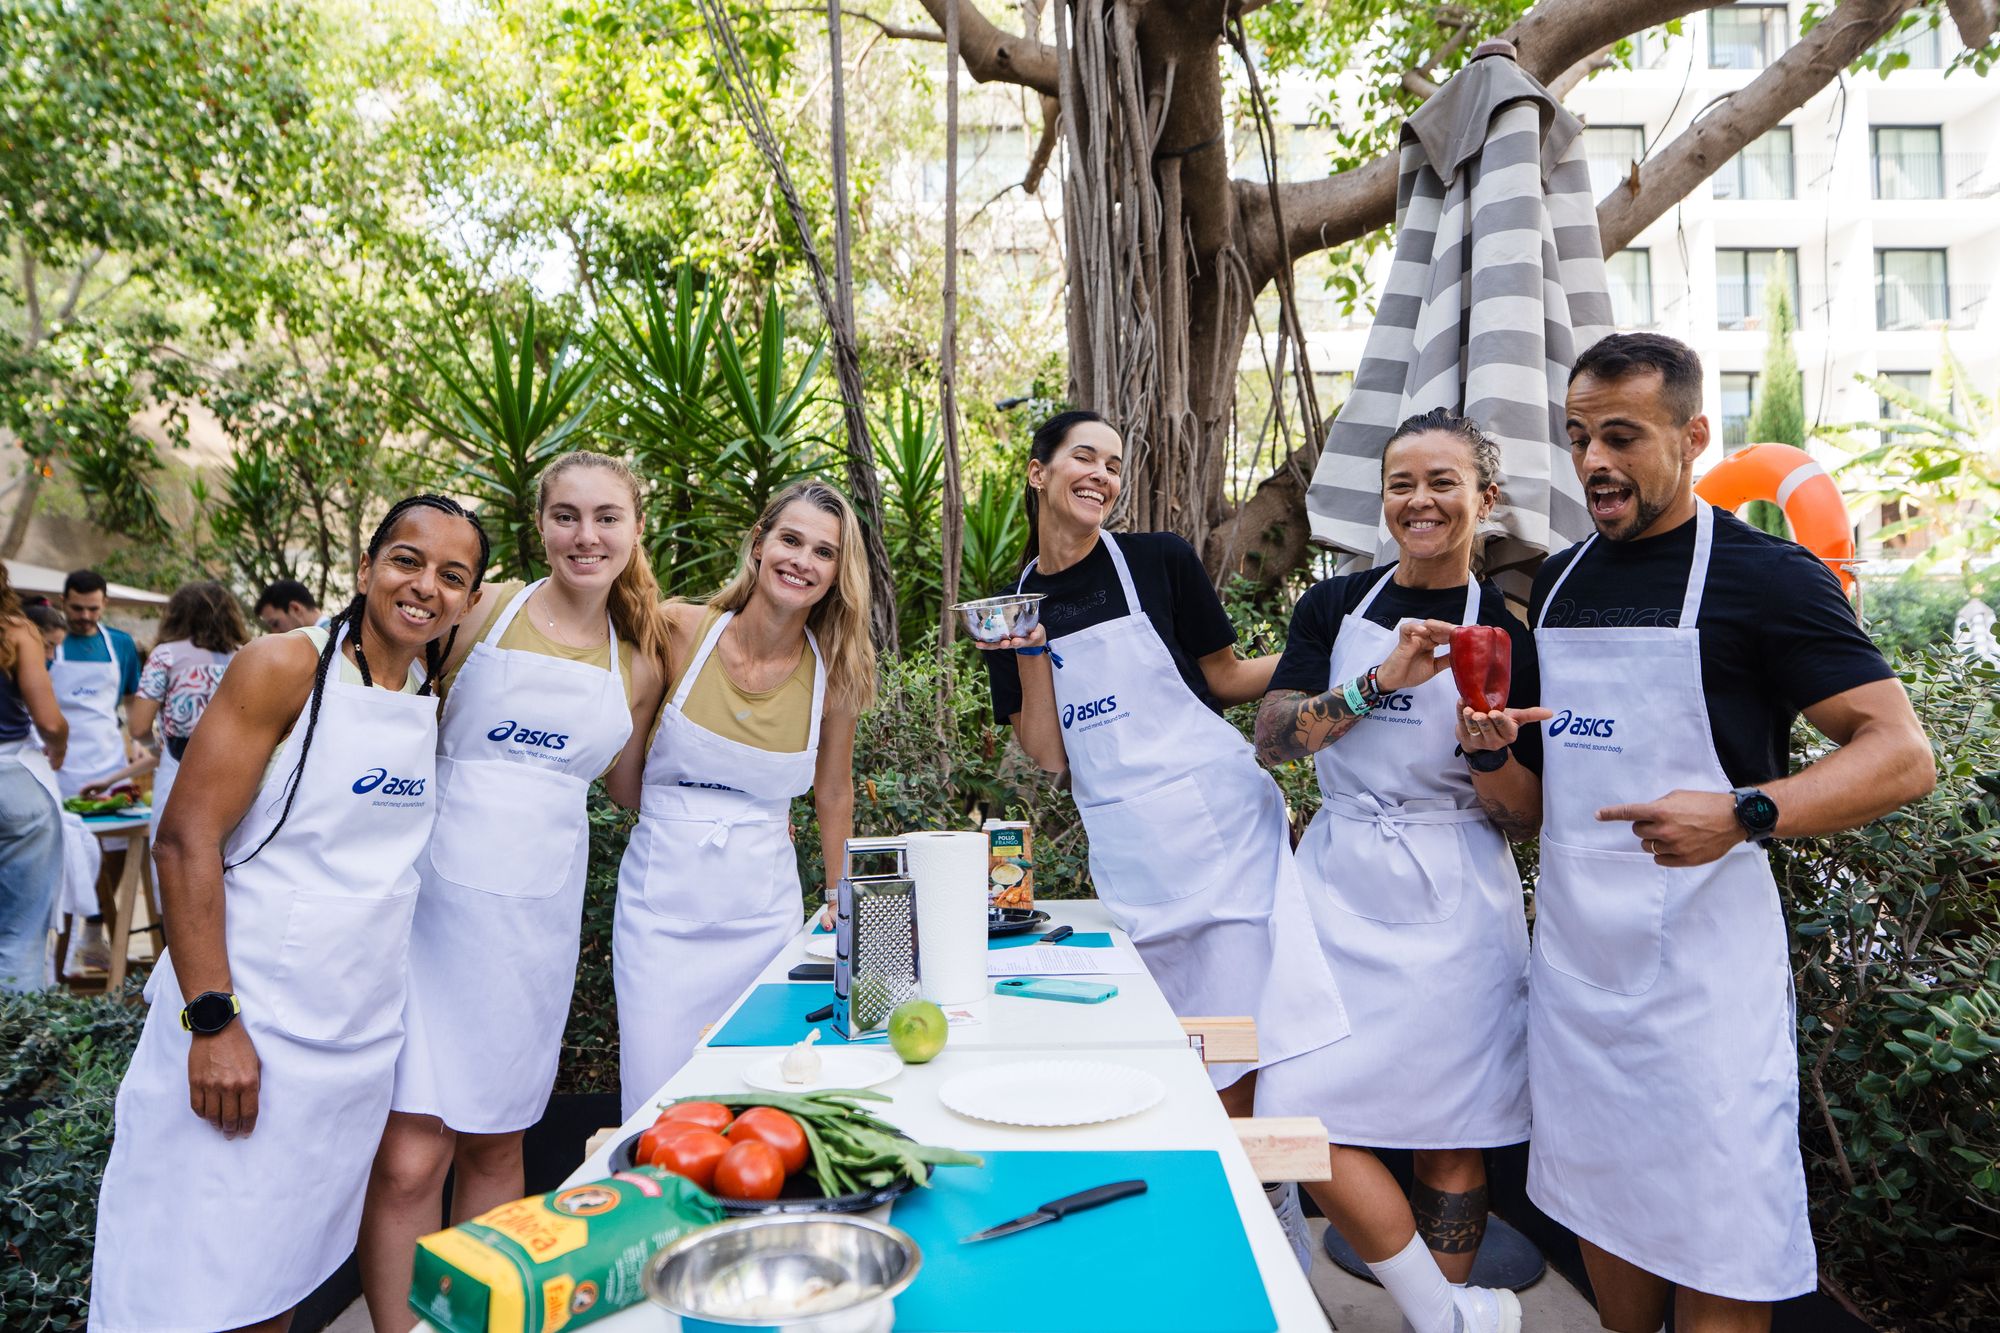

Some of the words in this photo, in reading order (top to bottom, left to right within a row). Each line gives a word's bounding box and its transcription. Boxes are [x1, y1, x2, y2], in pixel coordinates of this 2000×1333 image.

[1077, 695, 1117, 721] asics
[1407, 718, 1422, 726] body
[1569, 717, 1615, 738] asics
[514, 728, 569, 750] asics
[1608, 745, 1623, 753] body
